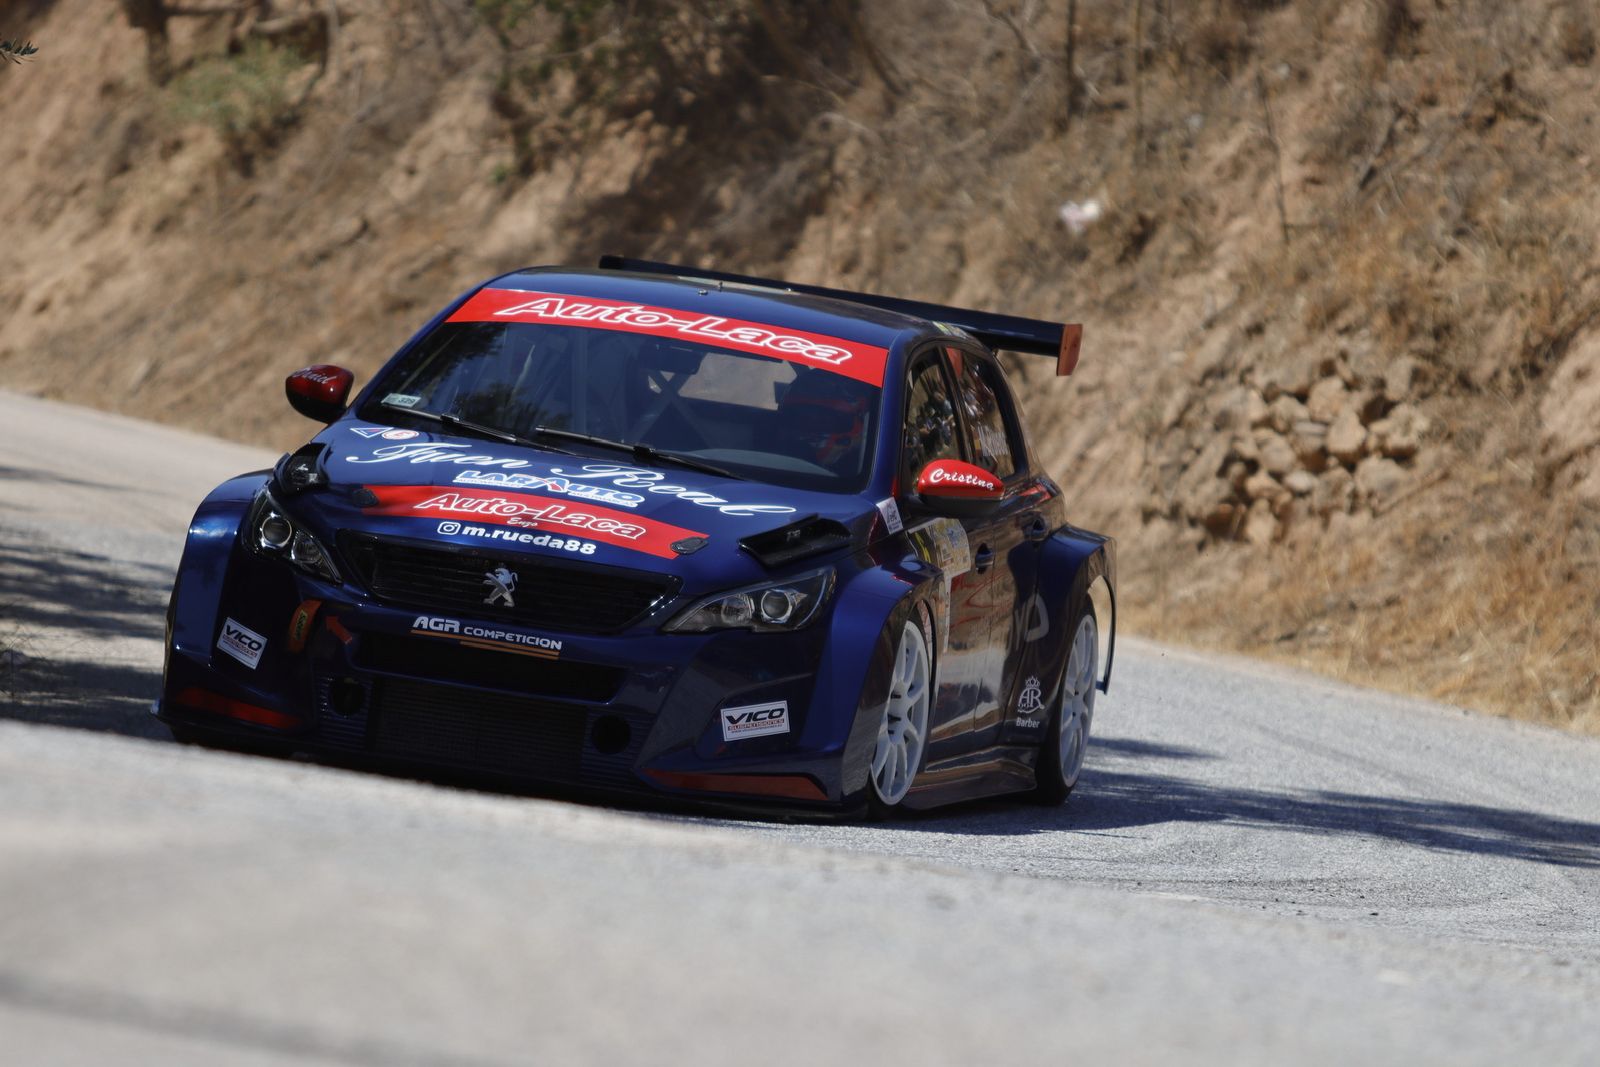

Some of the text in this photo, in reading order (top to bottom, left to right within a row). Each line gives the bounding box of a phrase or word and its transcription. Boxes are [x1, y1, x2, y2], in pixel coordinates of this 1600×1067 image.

[494, 296, 853, 366] Auto-Laca
[928, 468, 996, 491] Cristina
[412, 492, 647, 541] Auto-Laca
[461, 524, 597, 555] m.rueda88
[225, 624, 262, 652] VICO
[412, 616, 562, 650] AGR COMPETICION
[725, 707, 785, 725] VICO
[1015, 716, 1041, 729] Barber
